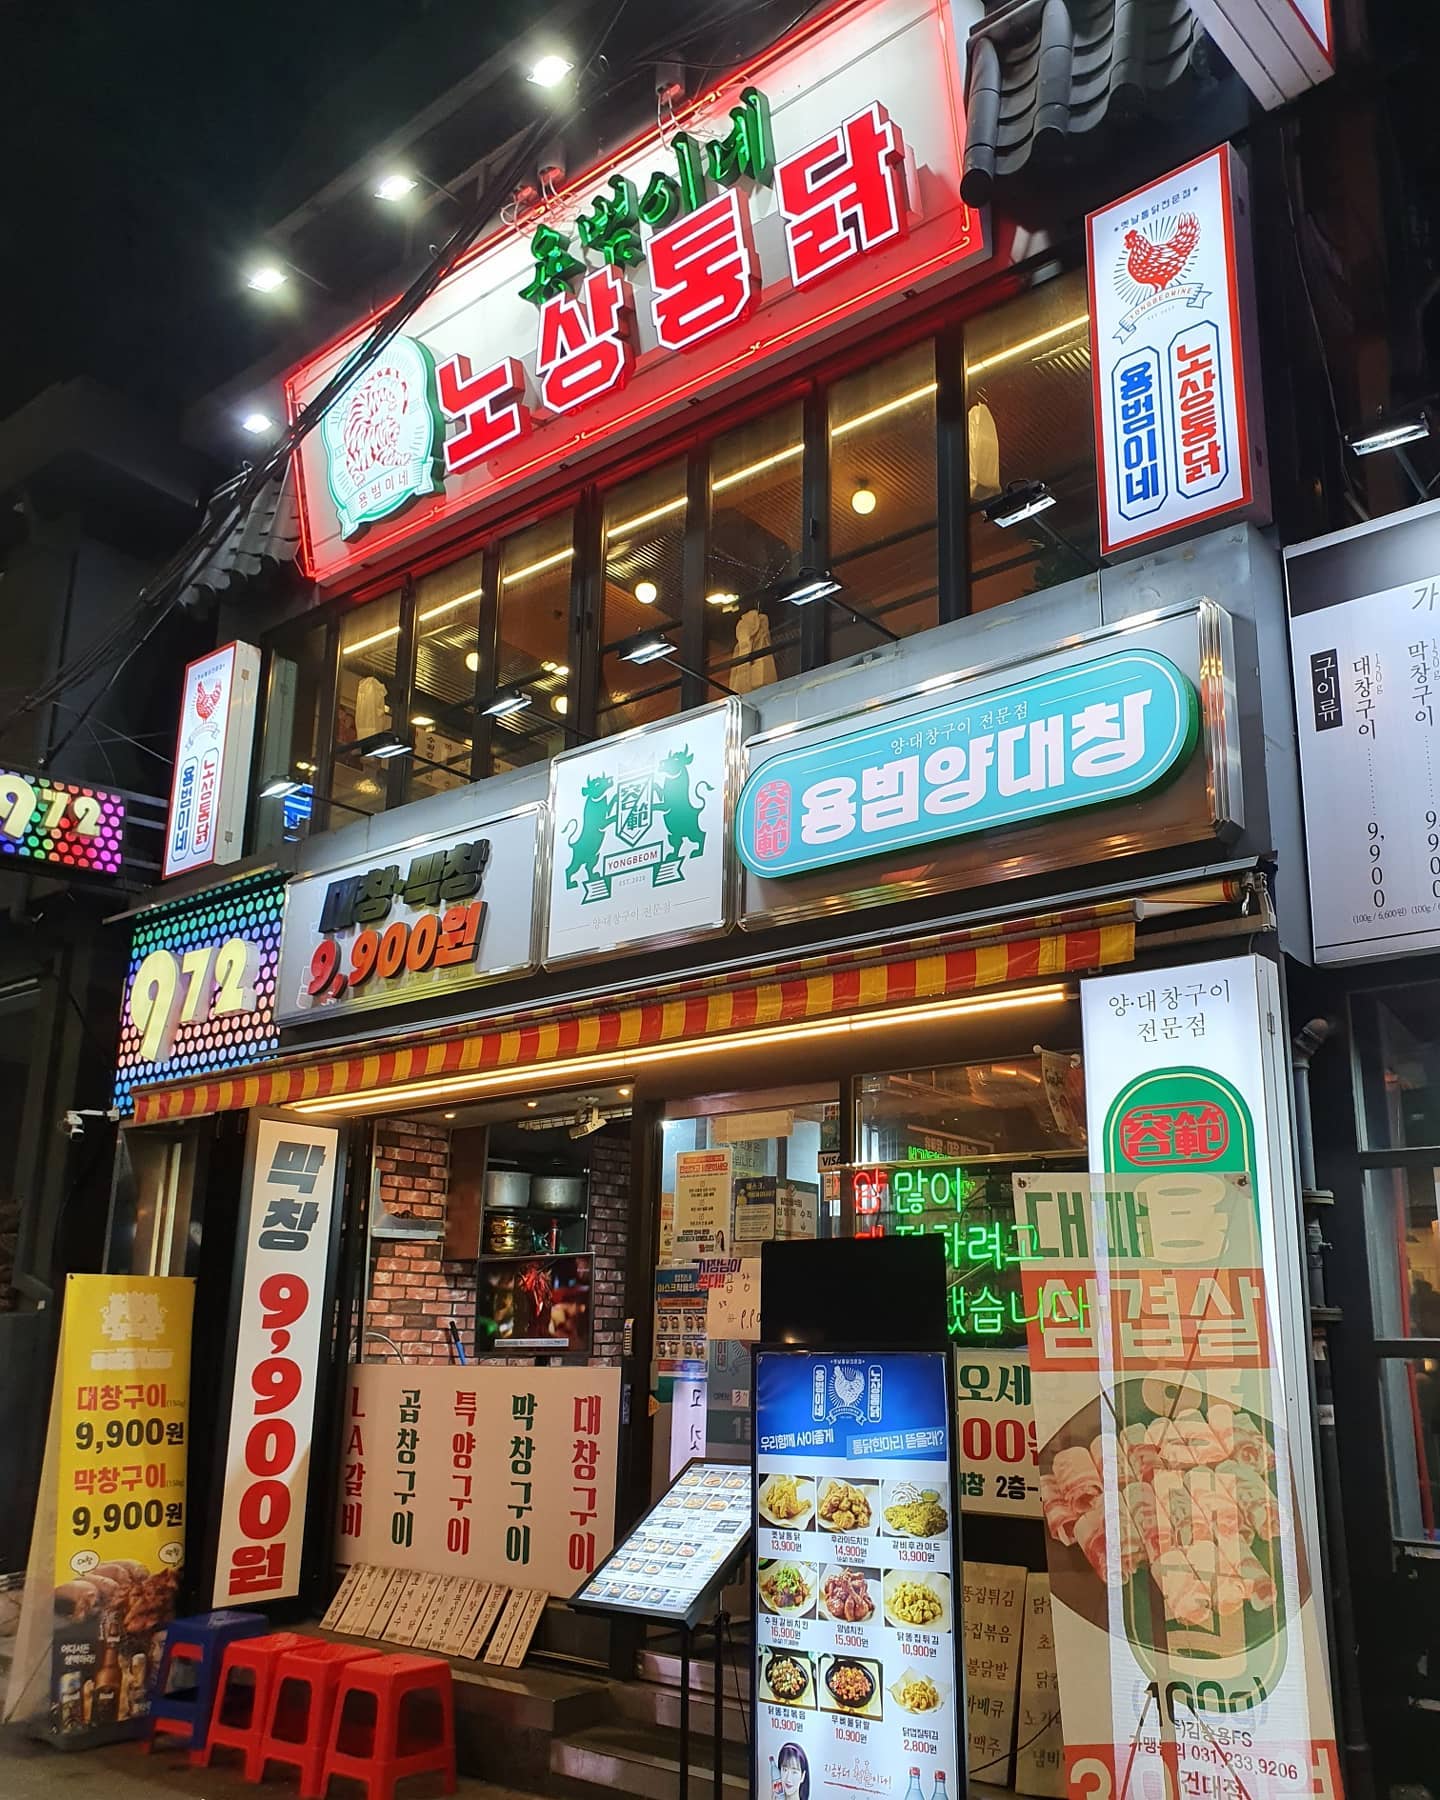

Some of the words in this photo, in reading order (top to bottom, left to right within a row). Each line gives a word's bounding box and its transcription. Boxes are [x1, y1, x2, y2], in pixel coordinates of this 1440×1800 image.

[519, 86, 774, 302] 용범이네
[437, 100, 902, 473] 노상통닭
[1120, 360, 1160, 504] 용범이네
[1176, 343, 1221, 485] 노상통닭
[358, 469, 409, 509] 용범이네
[1411, 582, 1440, 612] 가
[979, 701, 1030, 729] 전문점
[1314, 656, 1340, 723] 구이류
[1352, 655, 1377, 741] 대창구이
[1407, 640, 1434, 727] 막창구이
[800, 688, 1153, 846] 용범양대창
[175, 766, 195, 851] 용범이네
[195, 760, 215, 845] 노상통닭
[607, 850, 658, 871] YONGBEOM
[1367, 822, 1385, 908] 9,900
[308, 901, 487, 998] 9,900원
[130, 938, 257, 1063] 972
[1137, 1012, 1207, 1044] 전문점
[258, 1140, 326, 1252] 막창
[894, 1167, 962, 1213] 많이
[1025, 1191, 1155, 1258] 대파
[77, 1384, 168, 1412] 대창구이
[74, 1416, 185, 1454] 9,900원
[228, 1272, 310, 1597] 9,900원
[851, 1433, 904, 1455] 통닭한마리
[73, 1462, 167, 1496] 막창구이
[391, 1389, 422, 1548] 곱창구이
[446, 1390, 478, 1556] 특양구이
[505, 1392, 538, 1566] 막창구이
[568, 1394, 602, 1575] 대창구이
[71, 1498, 184, 1541] 9,900원
[834, 1633, 869, 1648] 15,900원
[836, 1623, 864, 1634] 양념치킨
[902, 1642, 937, 1657] 10,900원
[771, 1717, 804, 1733] 10,900원
[835, 1727, 868, 1745] 10,900원
[903, 1739, 937, 1755] 2,800원
